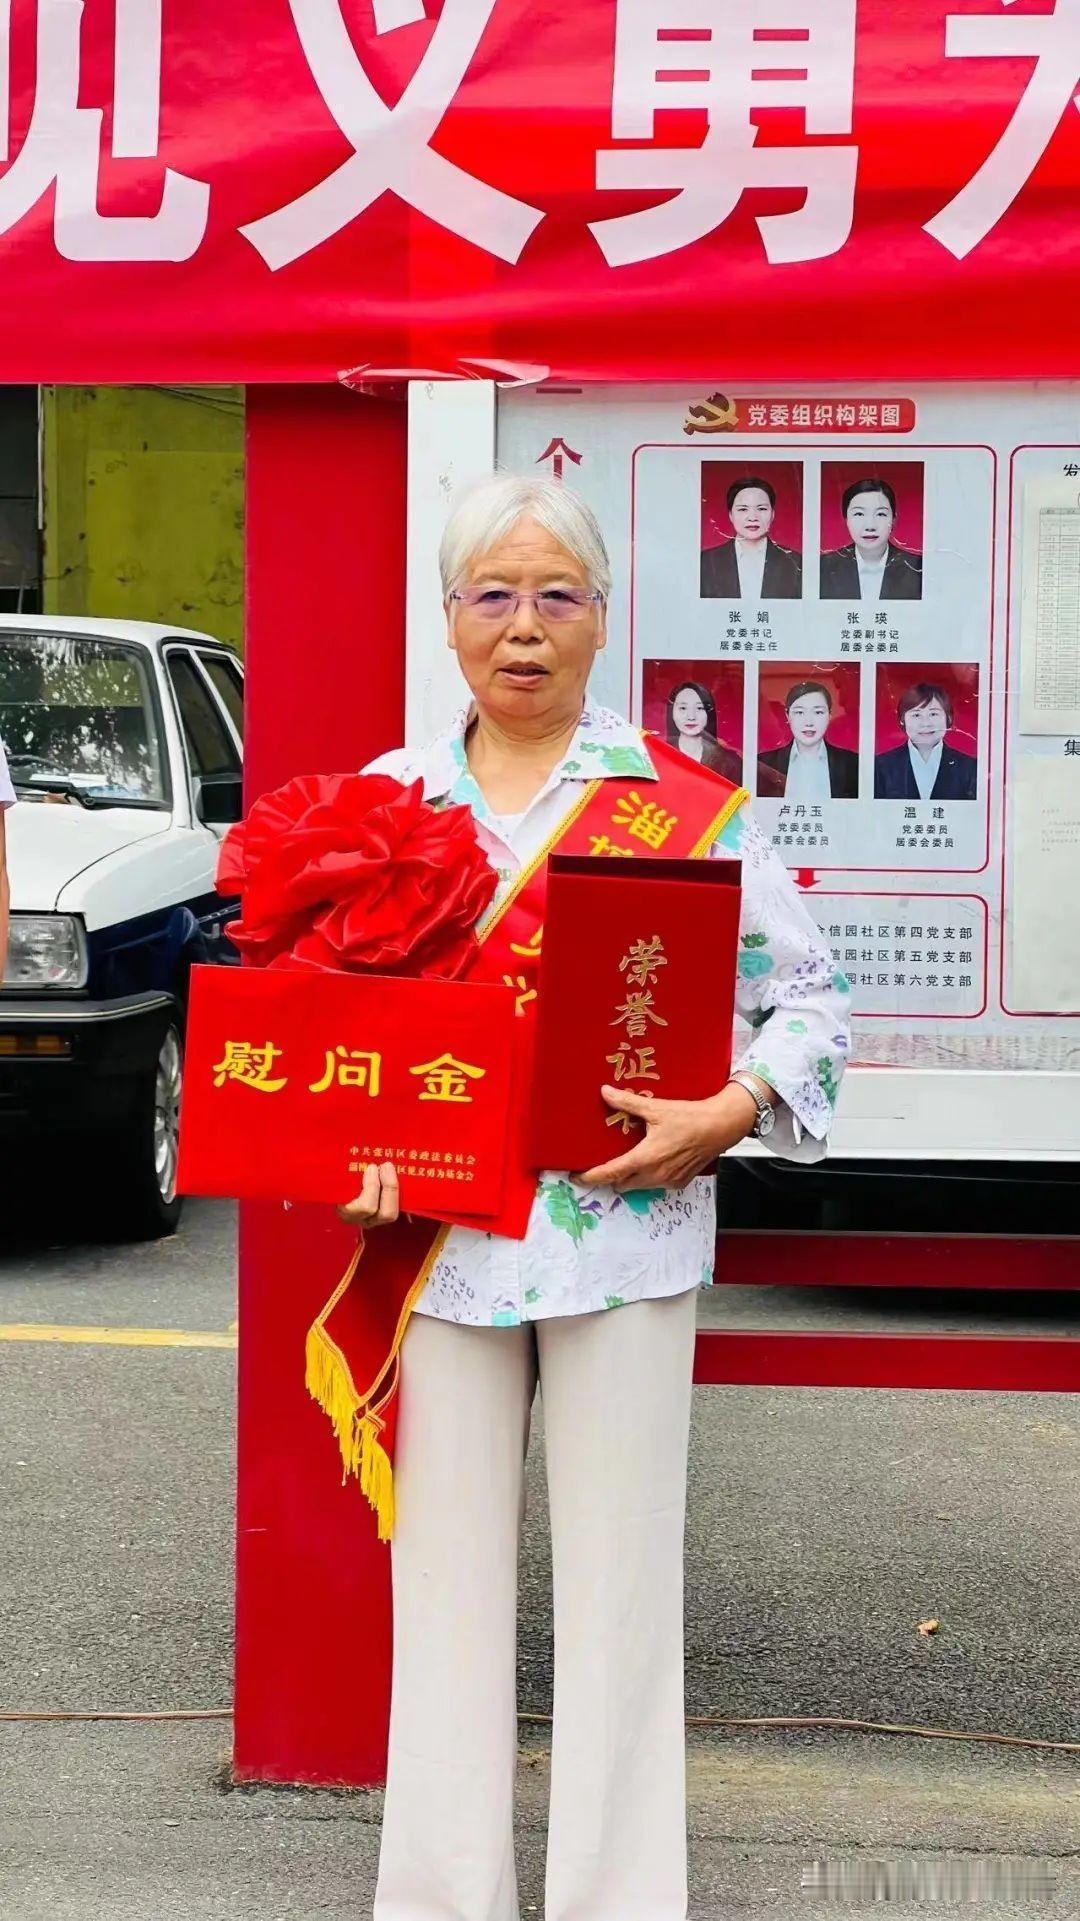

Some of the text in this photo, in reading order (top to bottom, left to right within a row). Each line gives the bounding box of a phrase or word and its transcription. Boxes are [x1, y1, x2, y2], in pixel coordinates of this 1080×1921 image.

[747, 403, 901, 428] 党委组织构架图
[726, 628, 773, 639] 党委书记
[840, 629, 900, 640] 党委副书记
[719, 640, 779, 652] 居委会主任
[840, 641, 900, 653] 居委会委员
[778, 804, 823, 818] 卢丹玉
[778, 822, 825, 834] 党委委员
[902, 824, 949, 835] 党委委员
[771, 835, 830, 847] 居委会委员
[895, 837, 955, 848] 居委会委员
[212, 1040, 487, 1103] 慰问金
